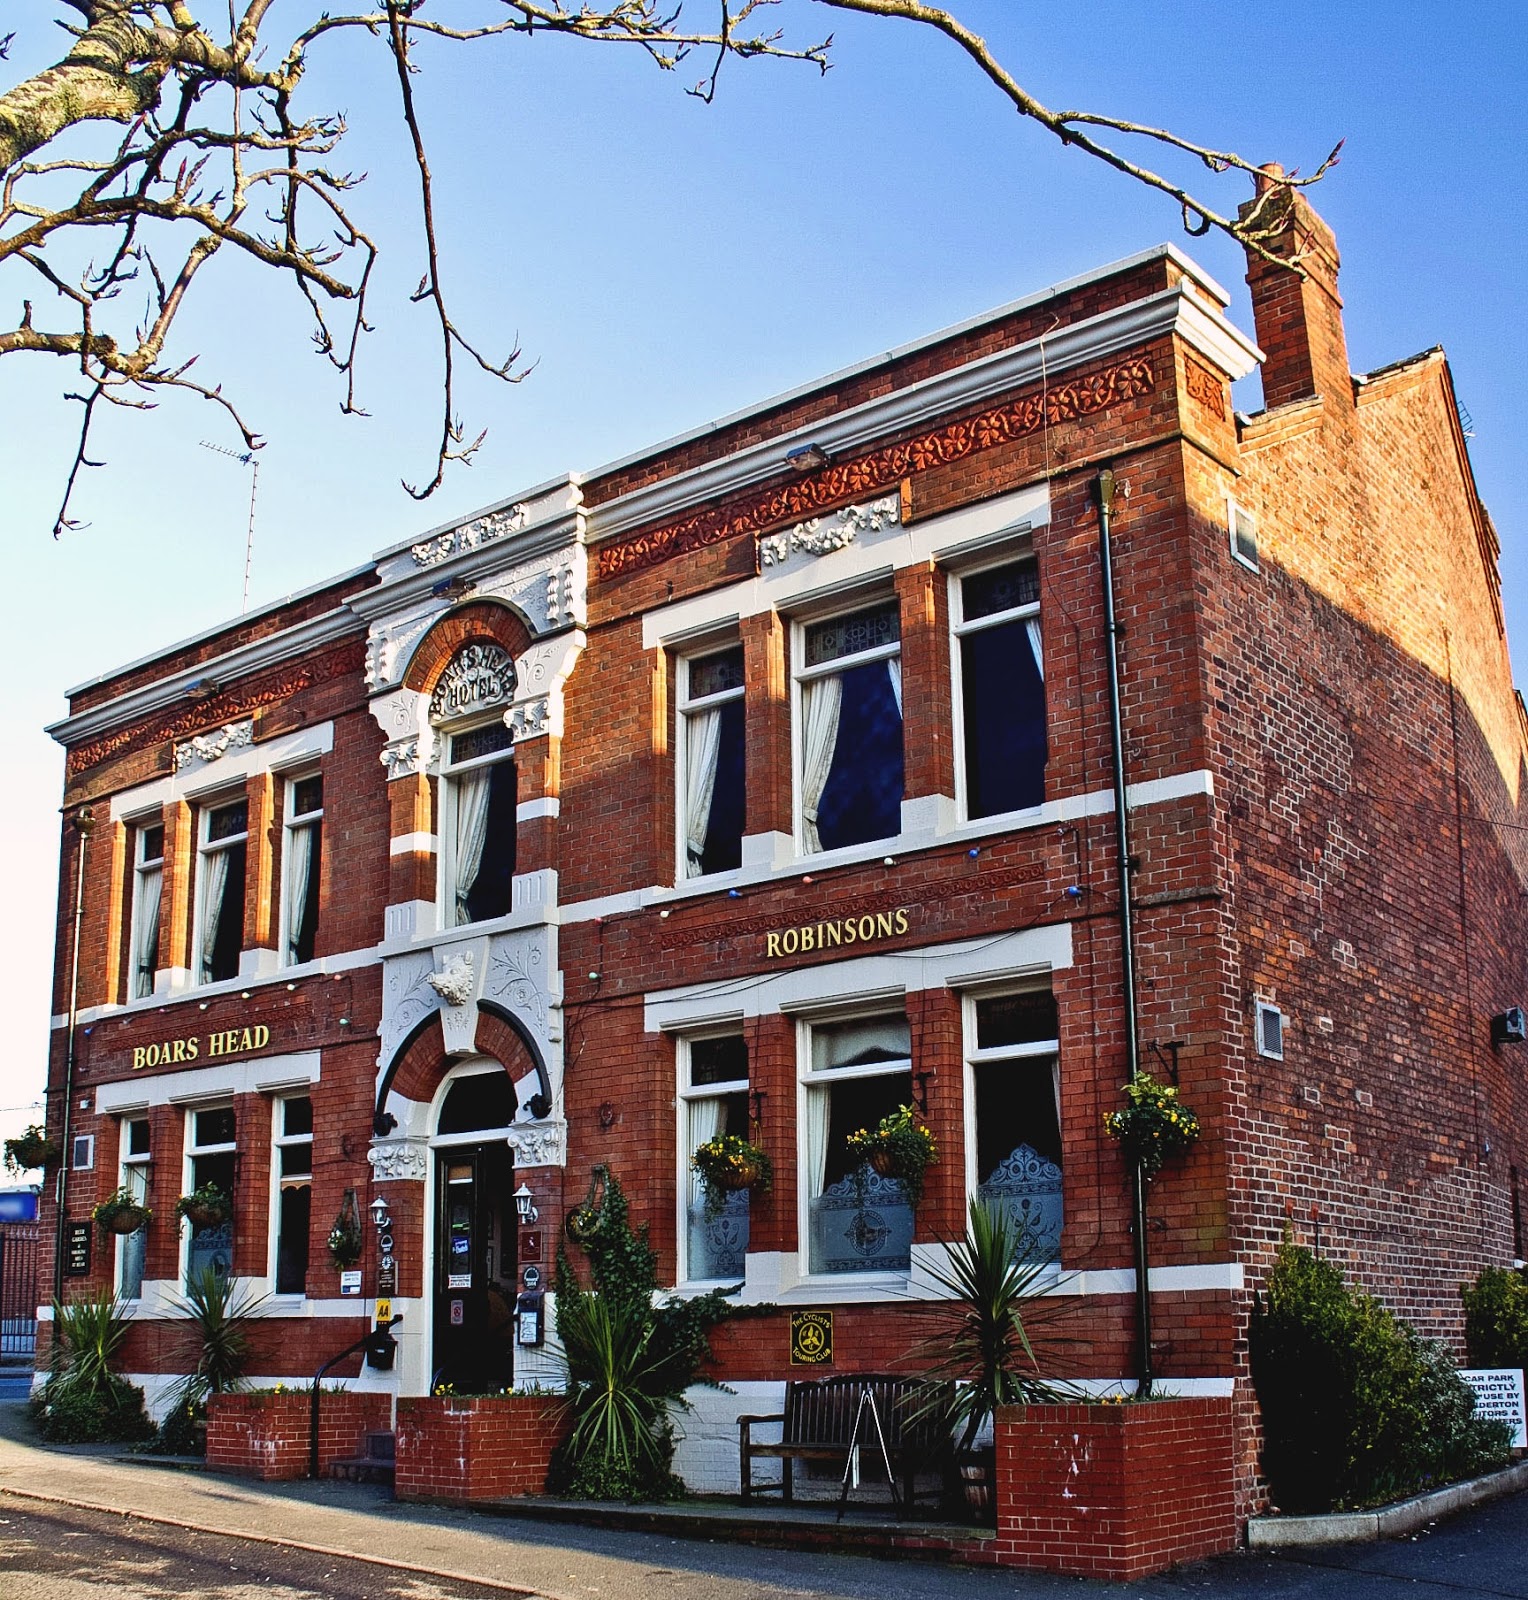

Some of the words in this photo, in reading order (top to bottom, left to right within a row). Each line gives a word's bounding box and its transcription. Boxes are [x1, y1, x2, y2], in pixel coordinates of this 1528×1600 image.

[450, 676, 500, 707] HOTEL
[766, 908, 909, 958] ROBINSONS
[132, 1036, 199, 1070] BOARS
[208, 1025, 270, 1057] HEAD
[378, 1305, 389, 1317] AA
[792, 1317, 803, 1328] THE
[793, 1346, 816, 1362] TOURING
[816, 1348, 831, 1361] CLUB
[1471, 1383, 1516, 1391] TRICTLY
